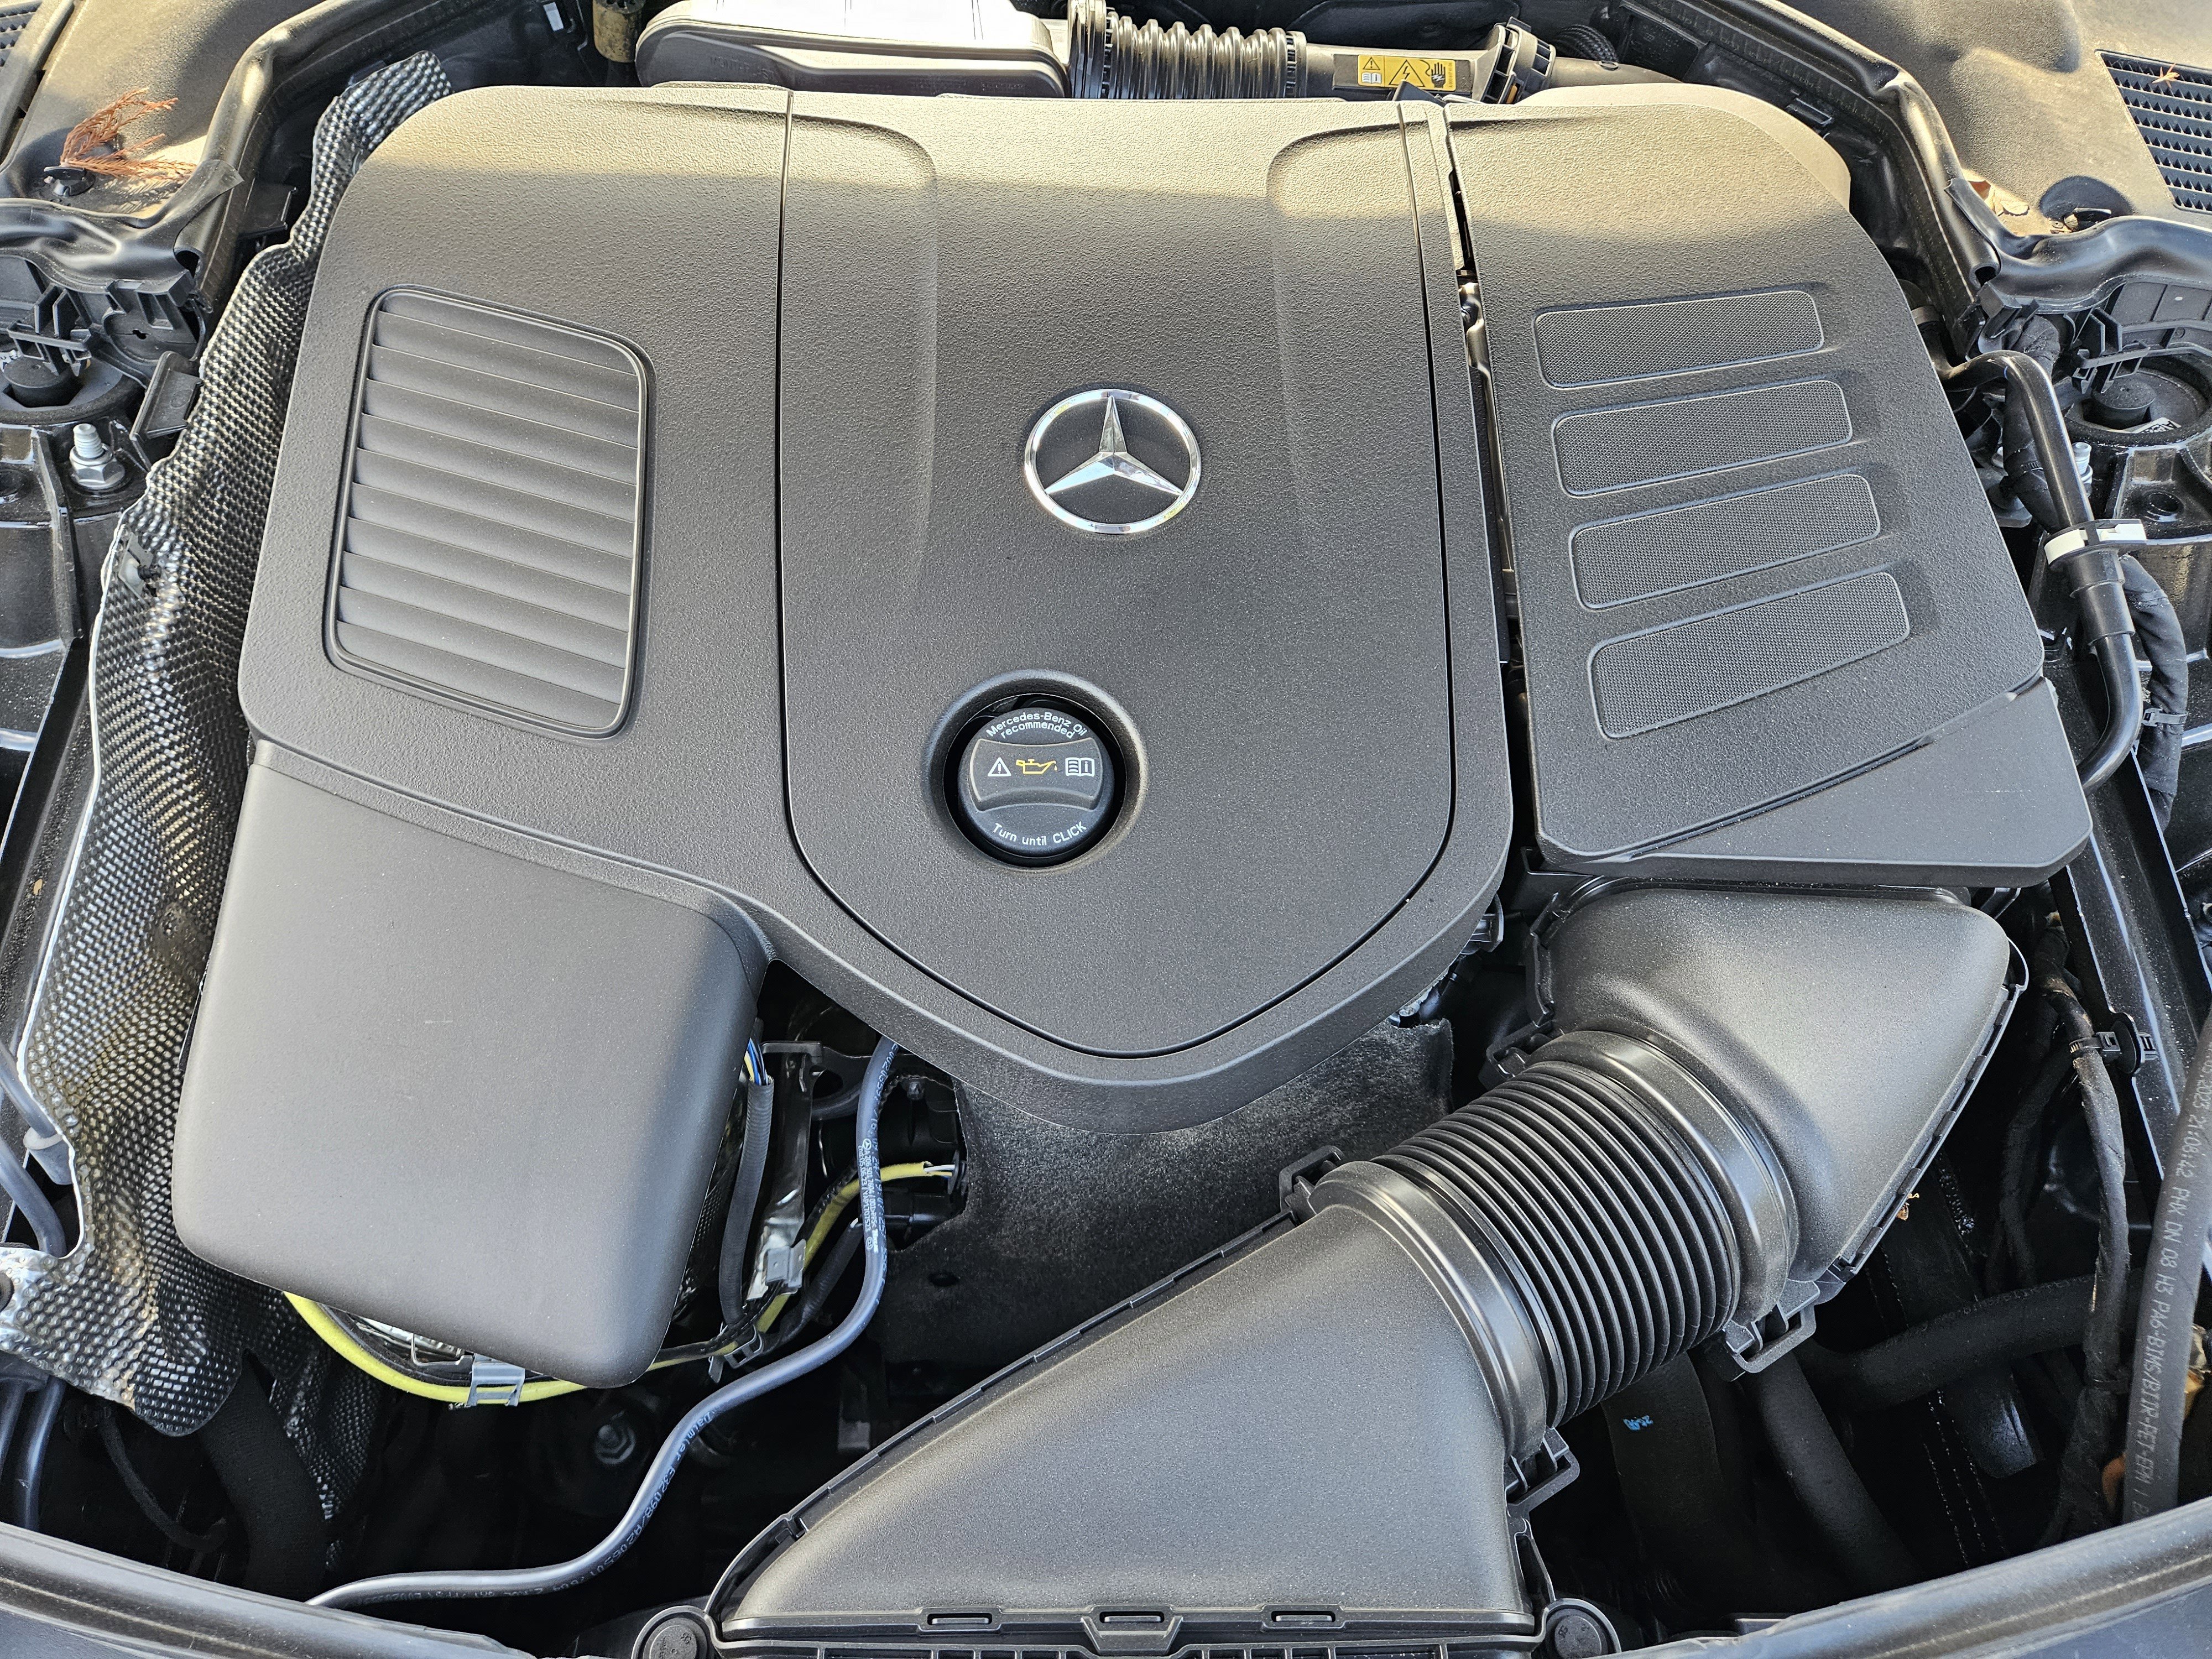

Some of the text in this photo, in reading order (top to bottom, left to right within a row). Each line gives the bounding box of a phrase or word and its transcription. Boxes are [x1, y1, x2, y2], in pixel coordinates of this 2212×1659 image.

[987, 712, 1088, 737] Mercedes-Benz Oil
[1000, 721, 1076, 739] recommended
[993, 821, 1087, 846] Turn until CLICK
[2176, 1114, 2206, 1178] 21:08:42
[2168, 1187, 2190, 1216] PHX
[2164, 1220, 2183, 1243] DN
[2160, 1248, 2178, 1268] 08
[2154, 1273, 2176, 1296] H3
